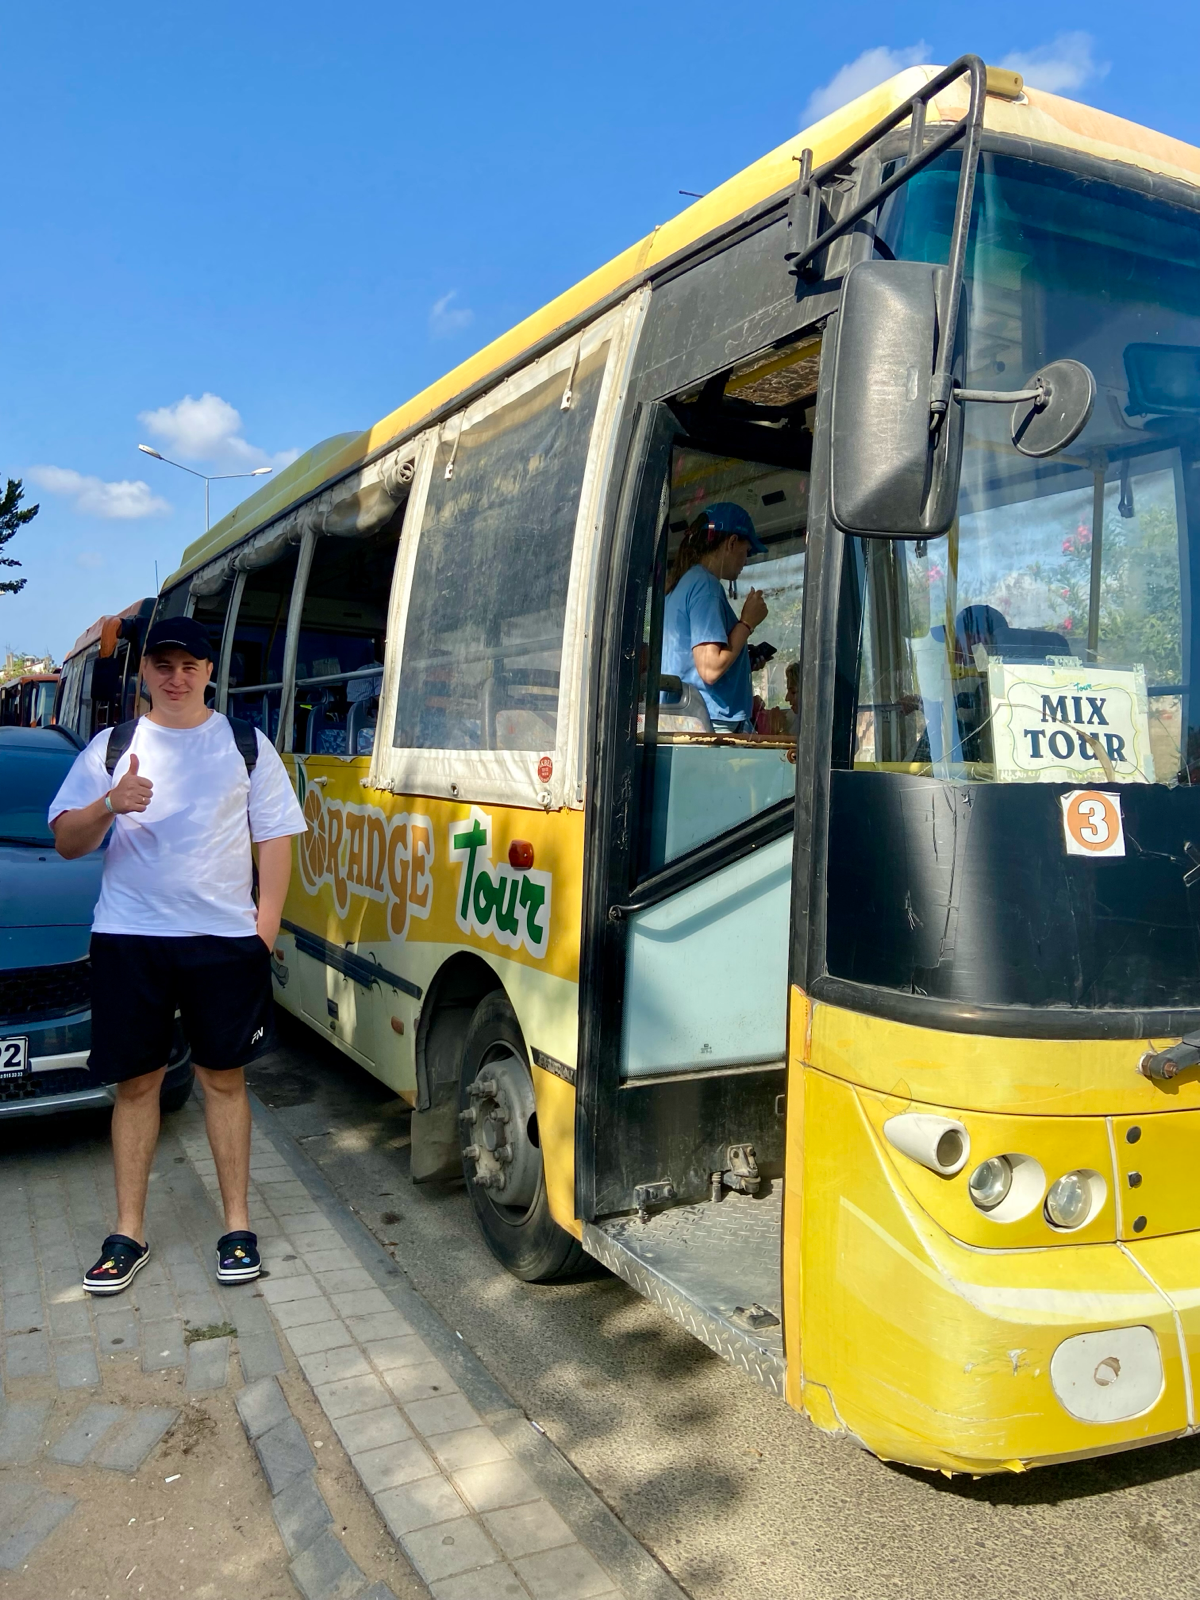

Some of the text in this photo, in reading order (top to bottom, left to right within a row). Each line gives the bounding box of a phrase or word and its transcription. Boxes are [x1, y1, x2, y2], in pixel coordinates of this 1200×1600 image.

[1040, 694, 1109, 725] MIX
[1024, 729, 1129, 762] TOUR
[1077, 799, 1110, 844] 3
